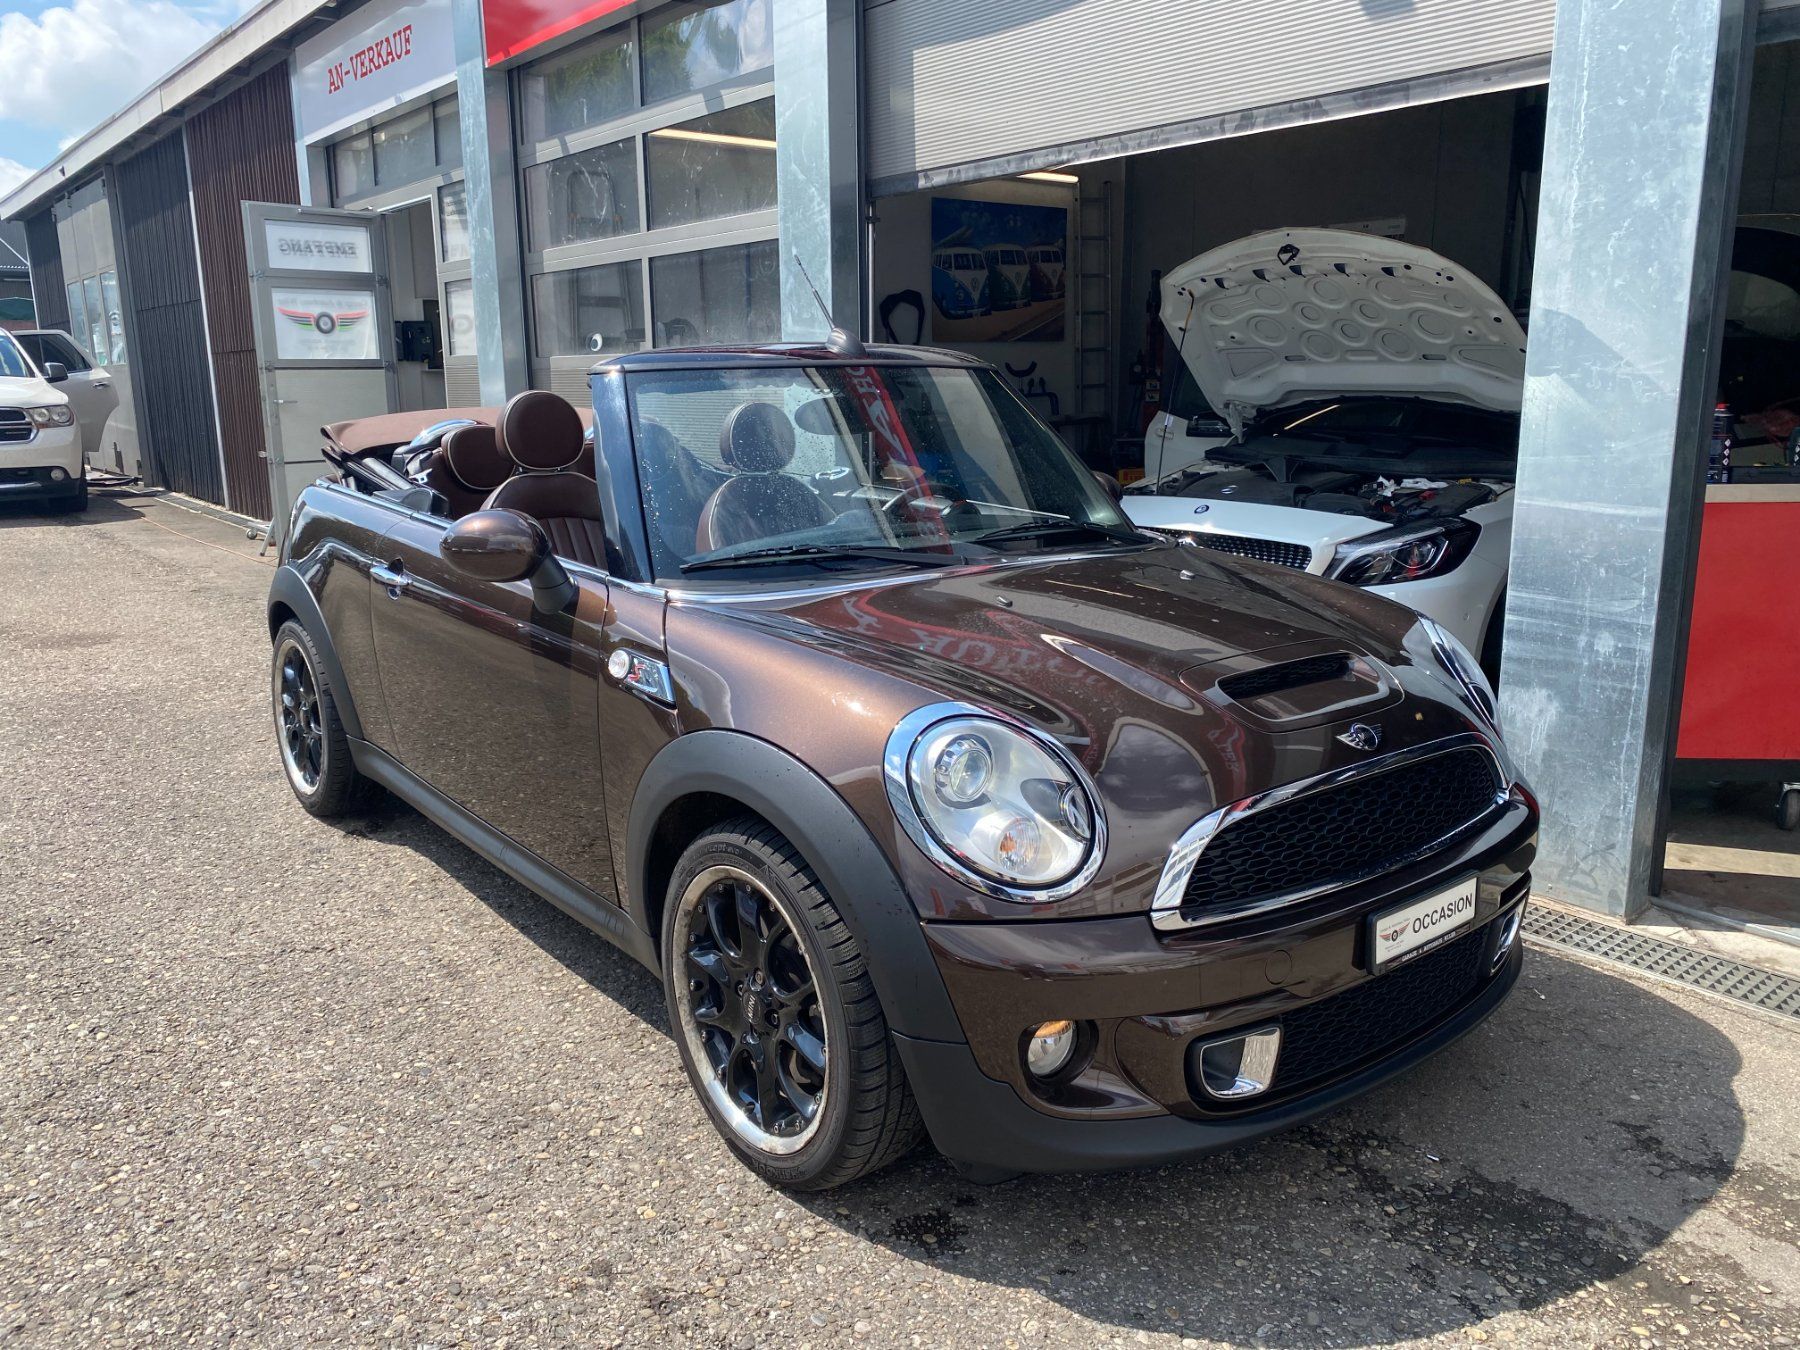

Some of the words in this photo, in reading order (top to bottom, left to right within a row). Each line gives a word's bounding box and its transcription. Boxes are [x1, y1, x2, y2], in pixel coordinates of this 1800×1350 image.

[327, 25, 413, 94] AN-VERKAUF
[1412, 893, 1473, 934] OCCASION
[747, 994, 756, 1019] MINI
